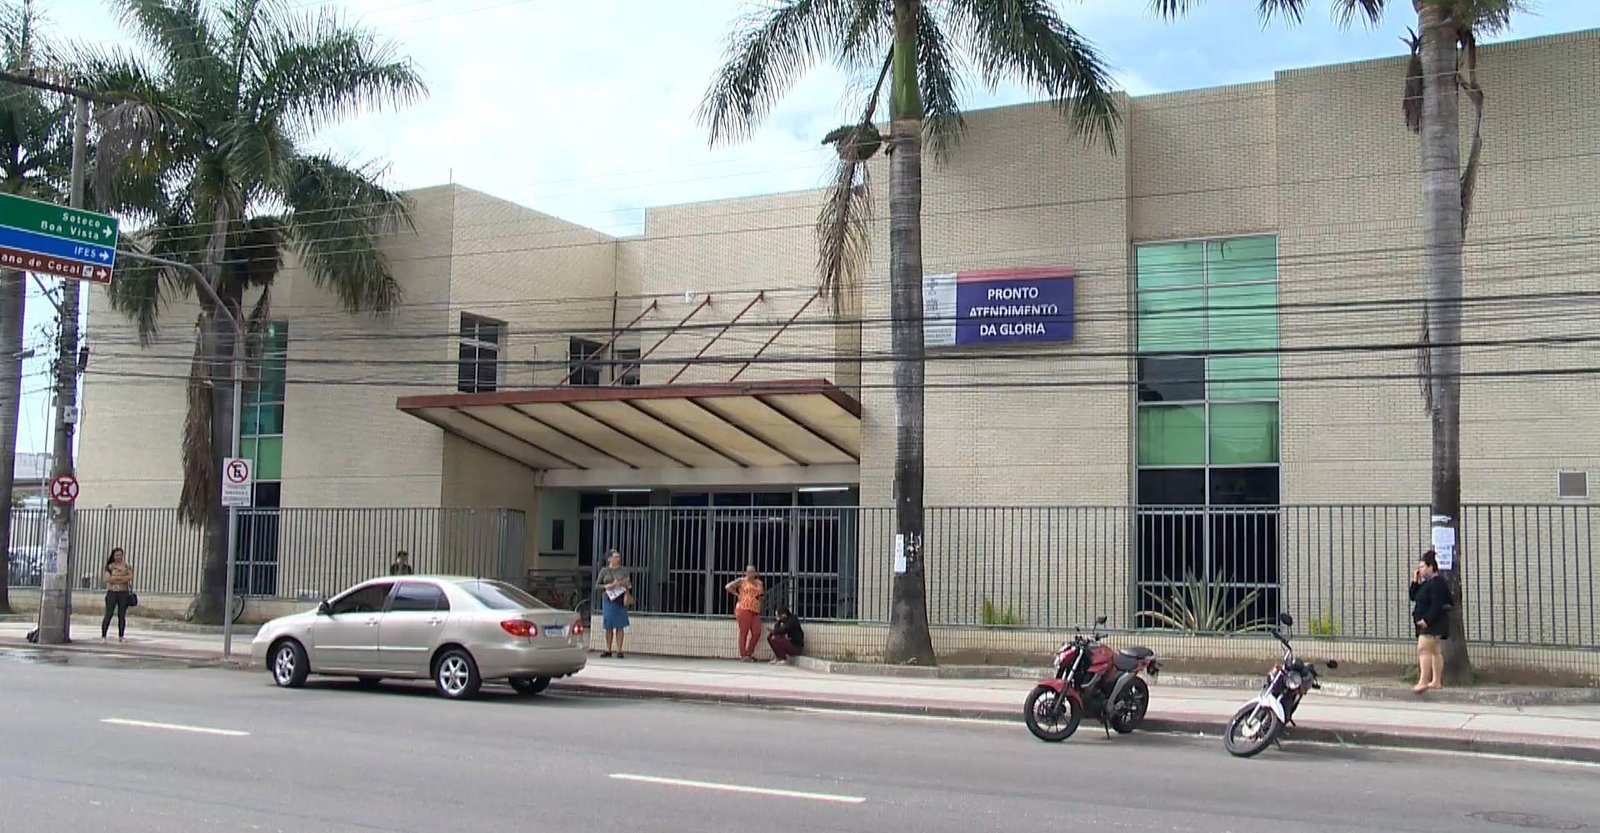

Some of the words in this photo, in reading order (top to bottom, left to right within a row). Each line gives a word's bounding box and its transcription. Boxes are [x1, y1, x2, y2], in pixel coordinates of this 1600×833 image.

[62, 212, 100, 228] Soteco
[41, 220, 62, 232] Boa
[70, 226, 99, 240] Vista
[74, 245, 96, 258] IFES
[28, 257, 42, 267] de
[48, 260, 79, 274] Cocal
[987, 287, 1039, 300] PRONTO
[969, 304, 1058, 318] ATENDIMENTO
[980, 324, 996, 336] DA
[1000, 321, 1046, 335] GLÓRIA
